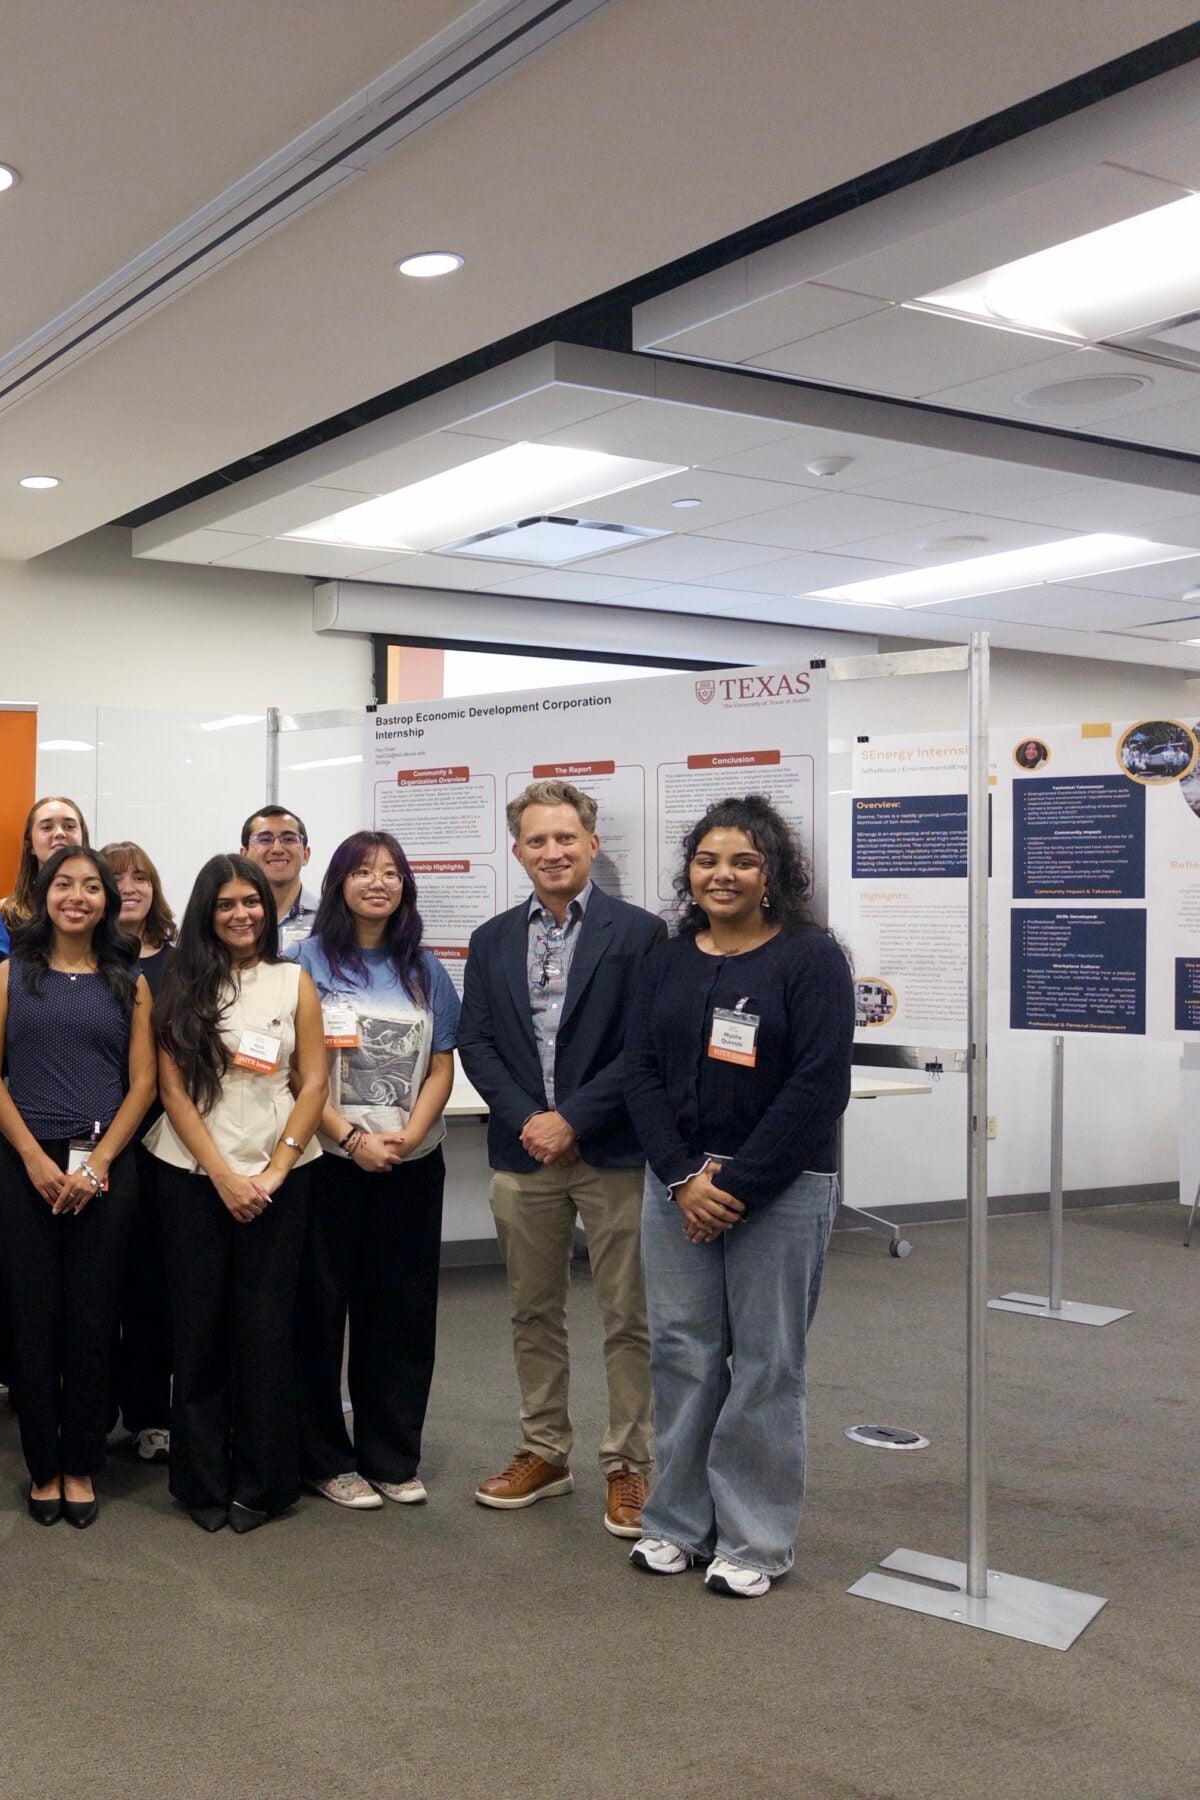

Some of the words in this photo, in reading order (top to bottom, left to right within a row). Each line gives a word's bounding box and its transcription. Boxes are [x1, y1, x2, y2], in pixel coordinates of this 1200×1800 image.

[719, 672, 811, 701] TEXAS
[734, 700, 760, 709] University
[769, 698, 784, 706] Texas
[376, 713, 413, 728] Bastrop
[416, 709, 466, 723] Economic
[469, 703, 539, 718] Development
[542, 696, 612, 712] Corporation
[375, 727, 424, 741] Internship
[861, 748, 914, 761] SEnergy
[712, 756, 755, 765] Conclusion
[413, 770, 447, 778] Community
[569, 766, 592, 775] Report
[400, 778, 437, 787] Organization
[439, 776, 467, 785] Overview
[856, 801, 901, 810] Overview:
[434, 863, 464, 872] Highlights
[860, 892, 909, 901] Highlights:
[433, 949, 461, 958] Graphics
